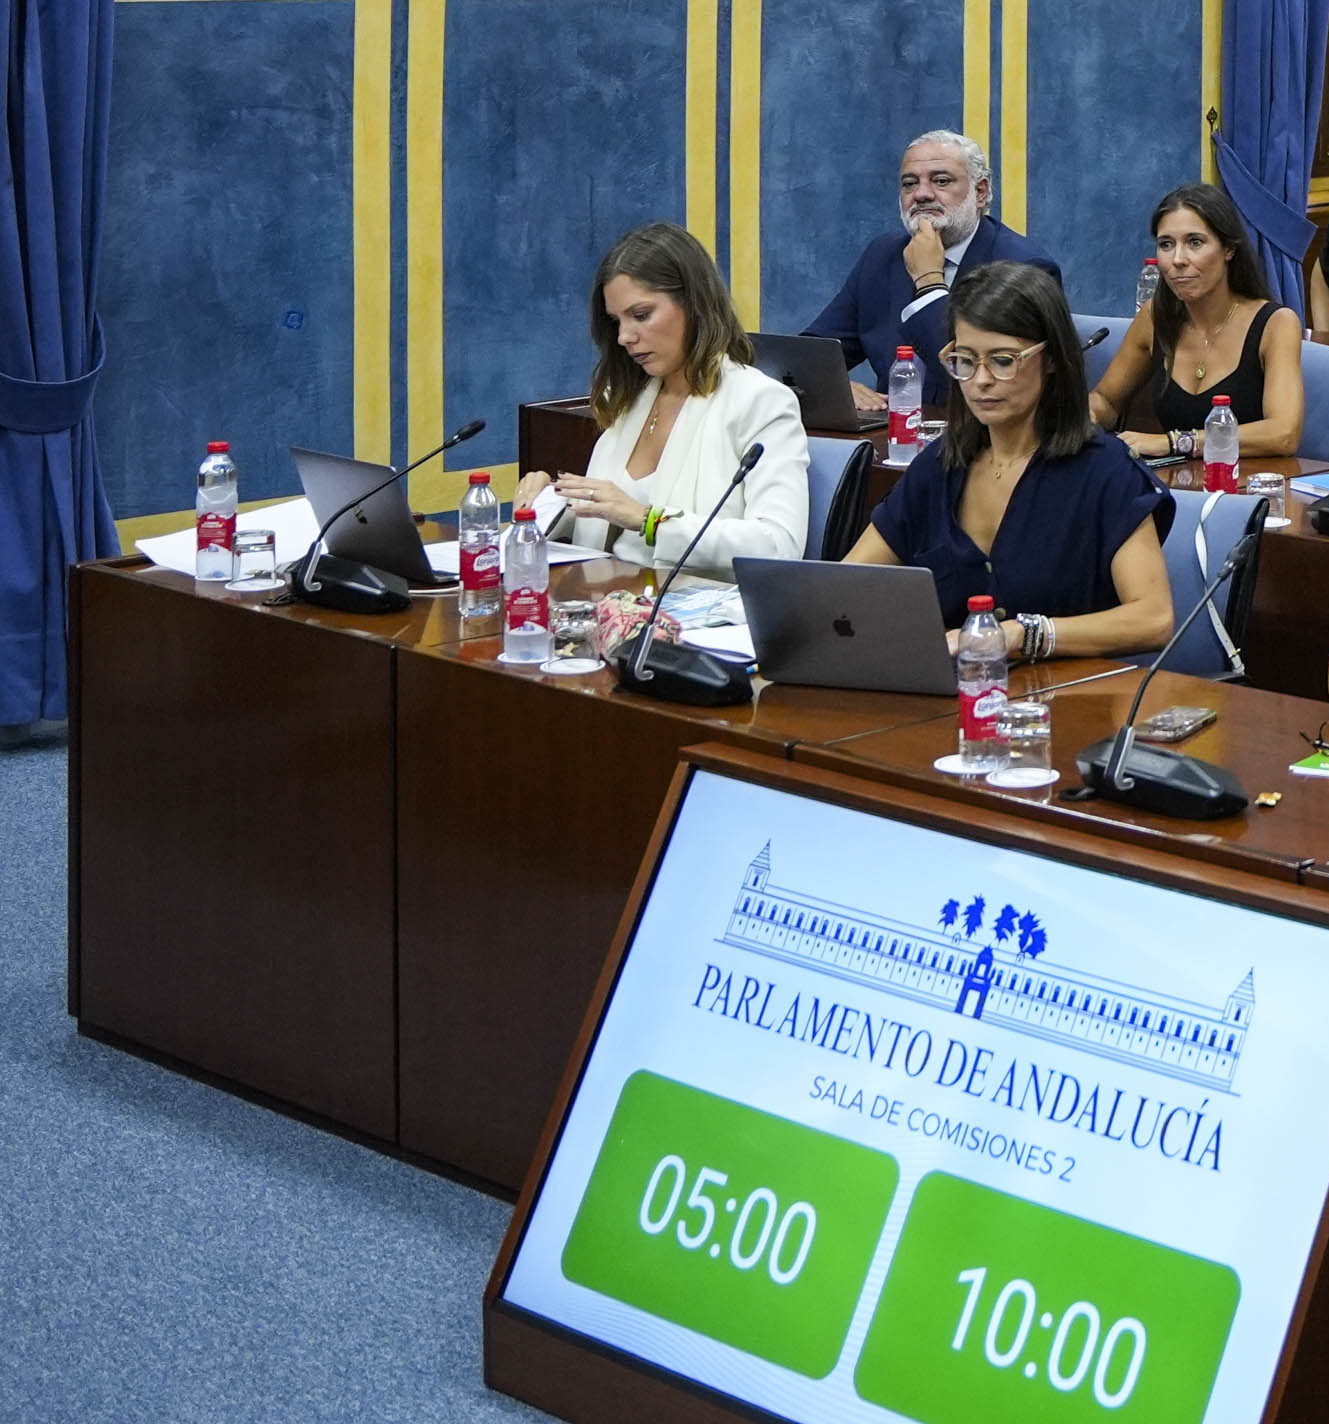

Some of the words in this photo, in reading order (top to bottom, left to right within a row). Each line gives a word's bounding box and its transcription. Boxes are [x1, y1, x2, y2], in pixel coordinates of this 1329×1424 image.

[691, 962, 934, 1079] PARLAMENTO
[936, 1039, 993, 1099] DE
[991, 1056, 1225, 1173] ANDALUCÍA
[808, 1074, 866, 1114] SALA
[870, 1094, 904, 1125] DE
[906, 1106, 1056, 1176] COMISIONES
[1057, 1154, 1077, 1184] 2
[638, 1153, 818, 1286] 05:00
[950, 1265, 1149, 1410] 10:00
